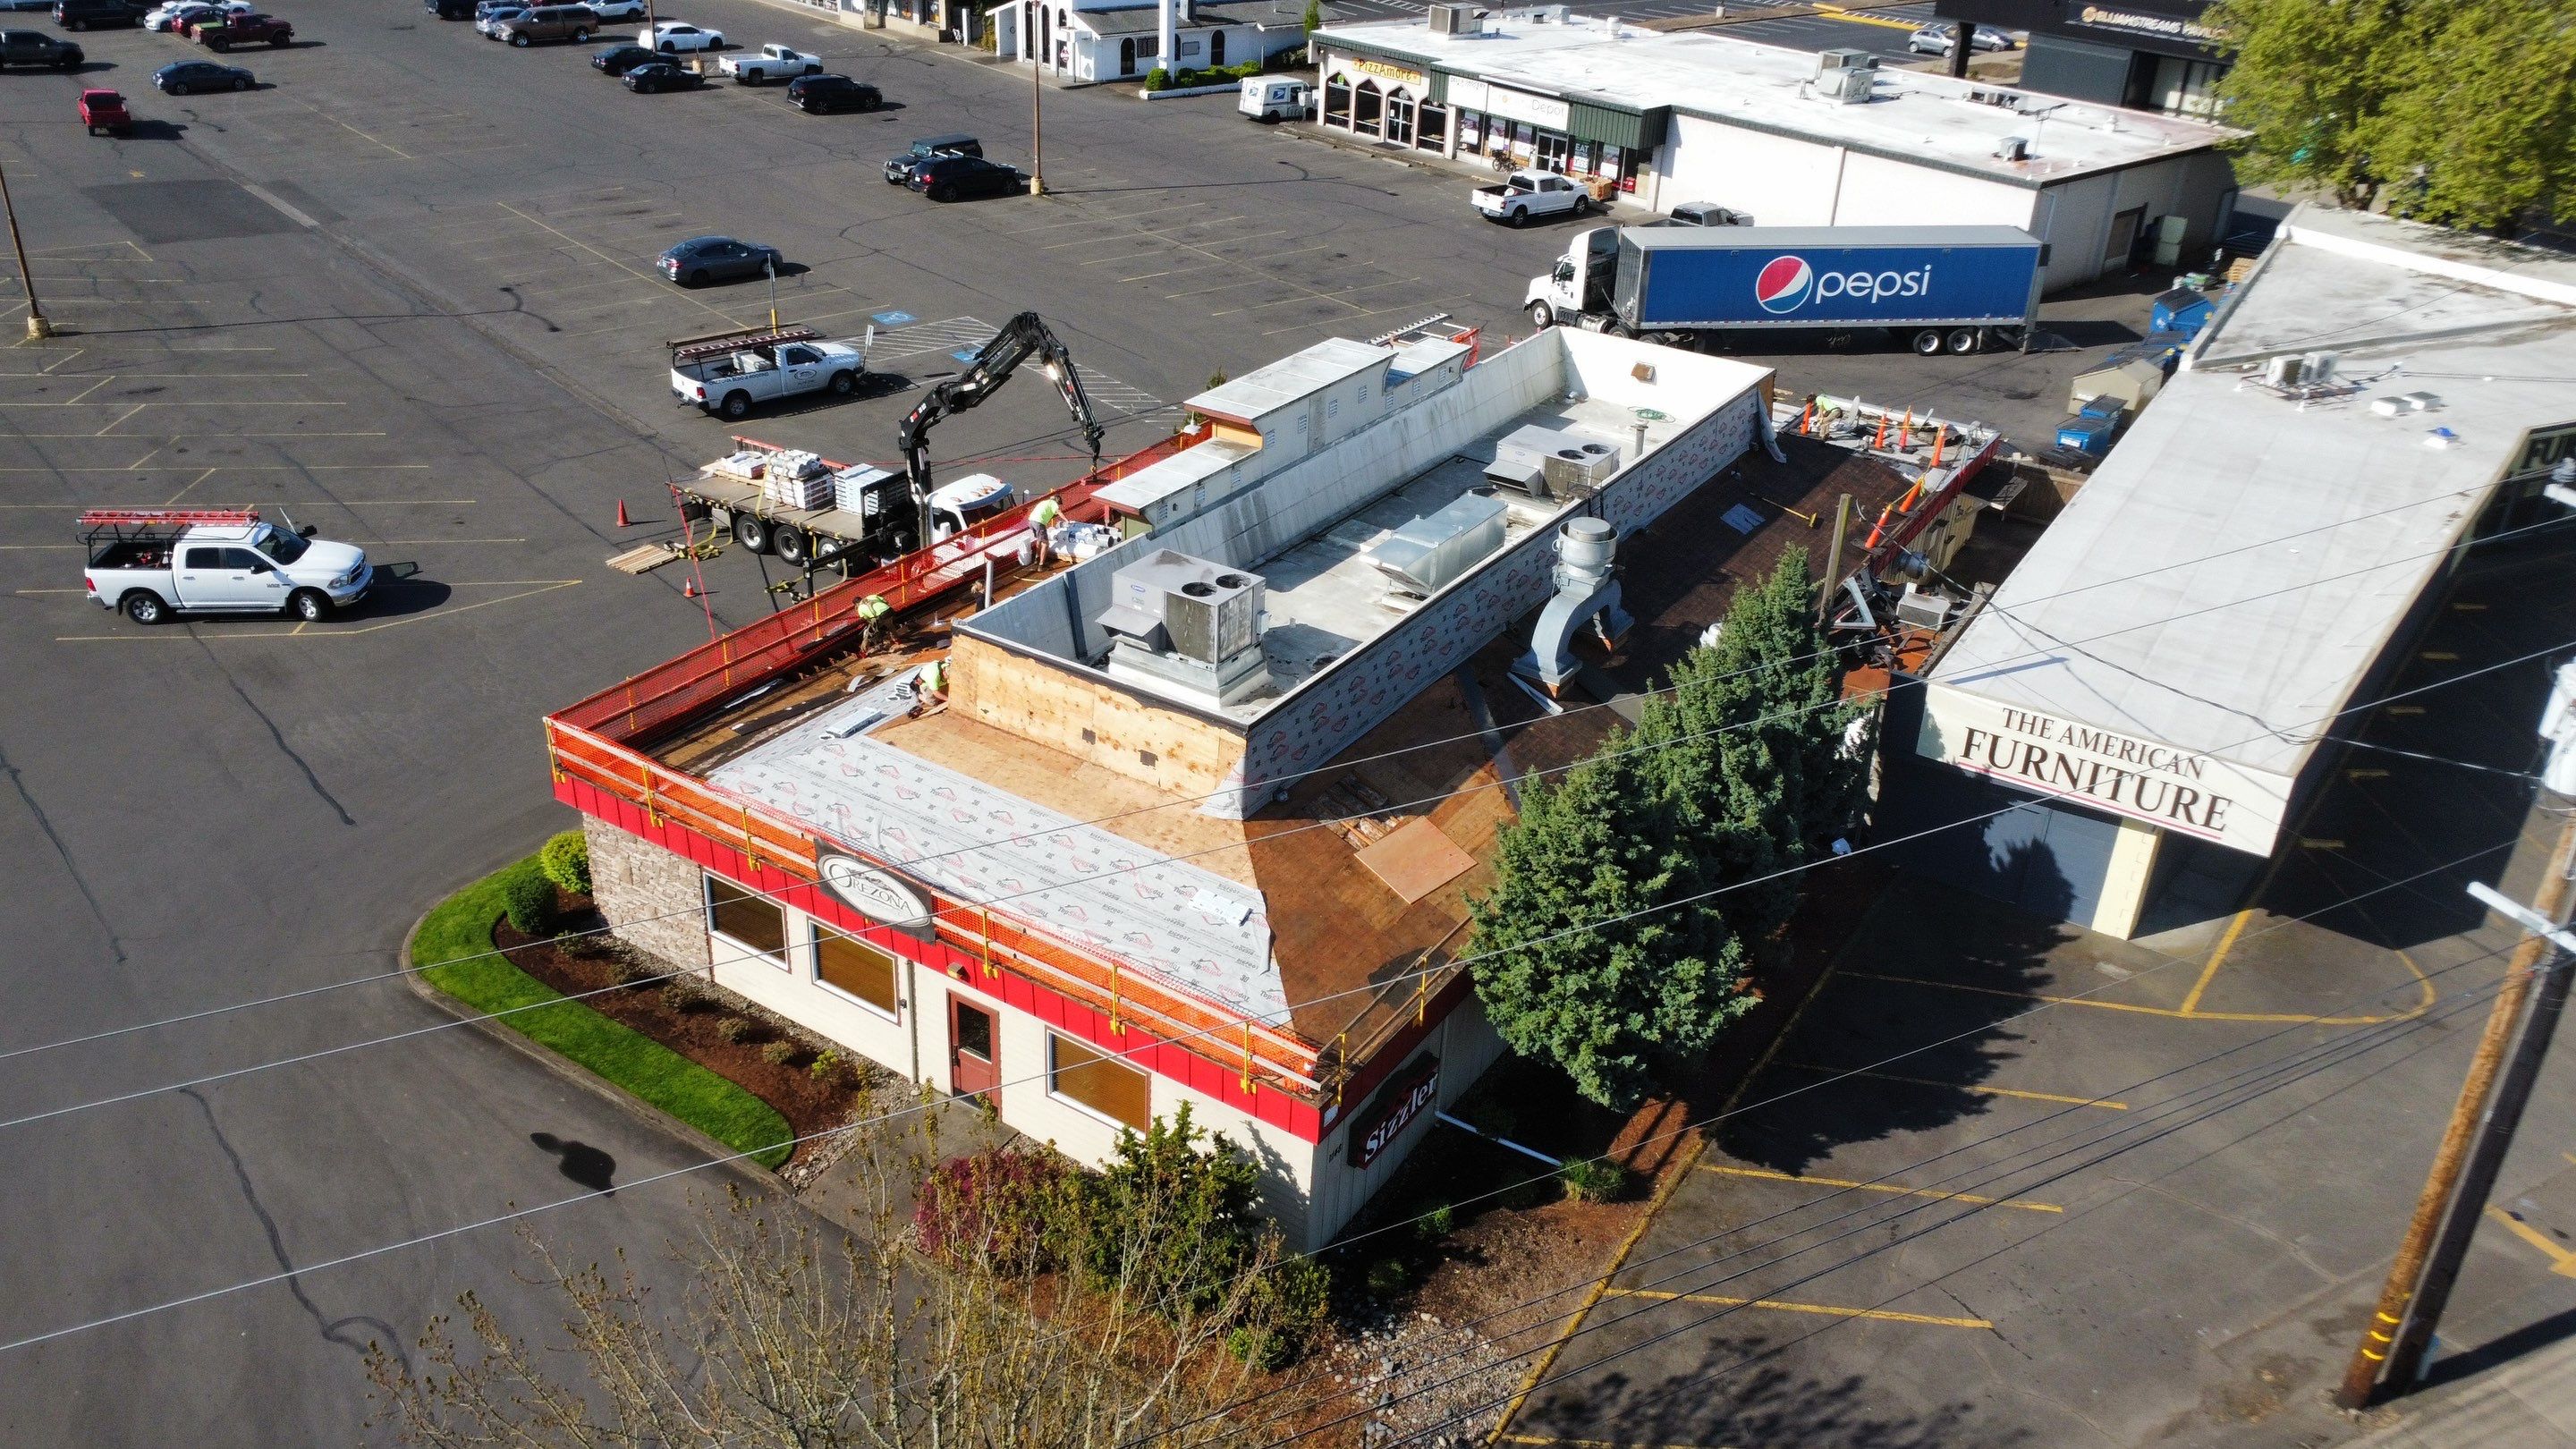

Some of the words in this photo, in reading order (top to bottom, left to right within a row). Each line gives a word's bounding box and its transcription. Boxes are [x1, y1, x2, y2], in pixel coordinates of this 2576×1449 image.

[1575, 143, 1589, 152] EAT
[1816, 264, 1931, 303] pepsi
[1959, 726, 2233, 833] FURNITURE
[2003, 708, 2055, 740] THE
[2060, 724, 2207, 781] AMERICAN
[1364, 1072, 1438, 1163] Sizzler
